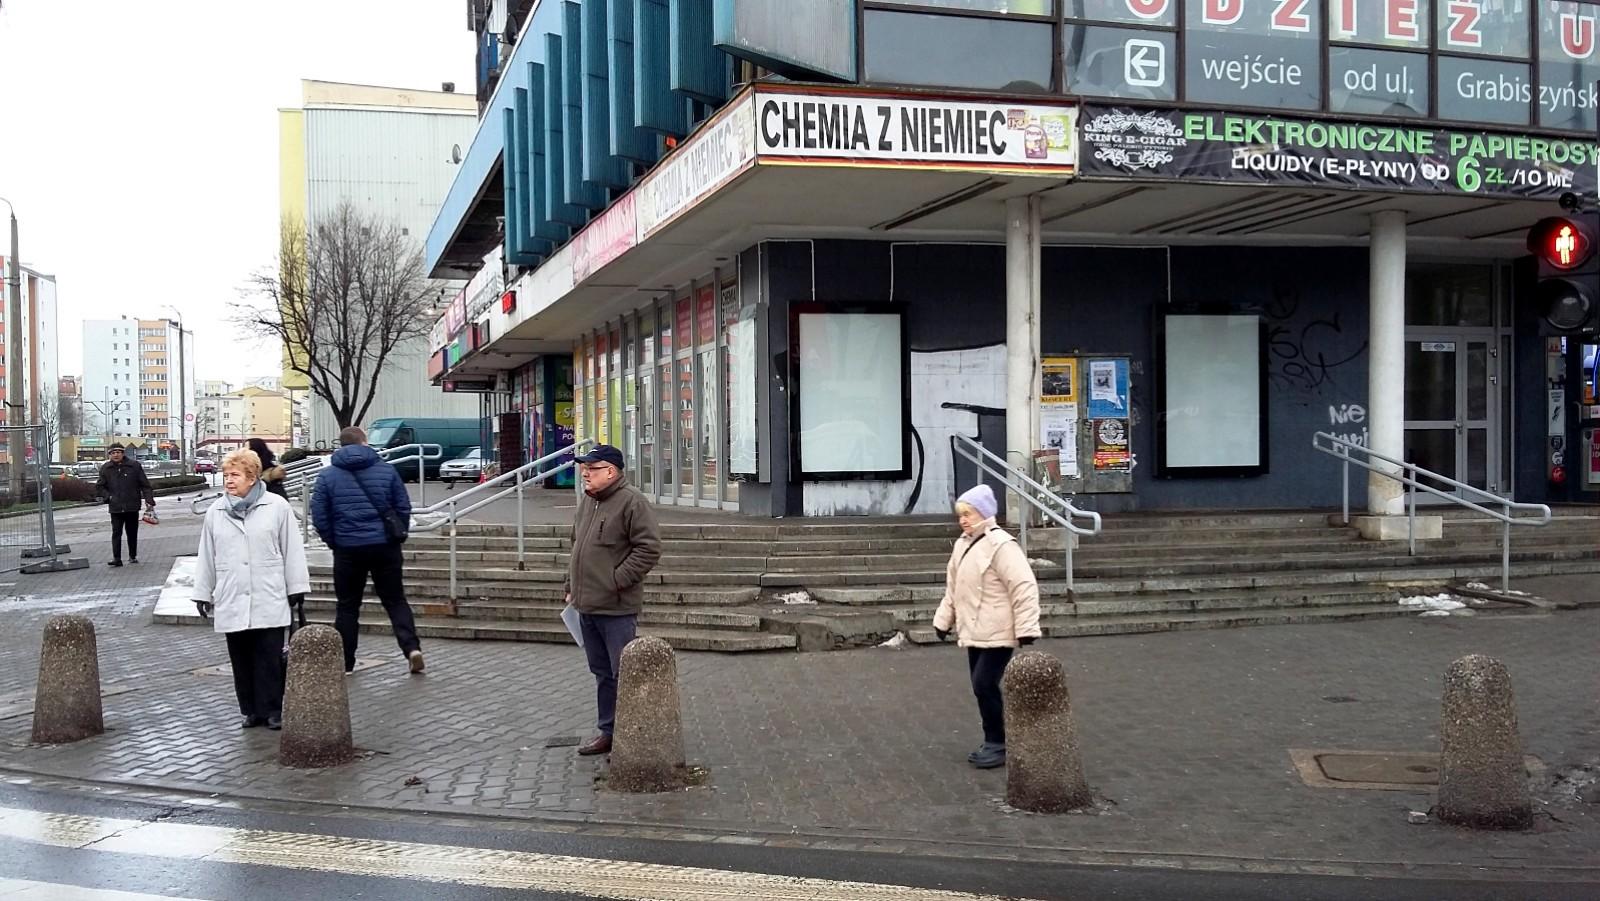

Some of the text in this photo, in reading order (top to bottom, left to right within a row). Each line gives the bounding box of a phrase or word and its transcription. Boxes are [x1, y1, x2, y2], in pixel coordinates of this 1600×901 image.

[1202, 54, 1302, 89] wejście
[1344, 64, 1377, 91] od
[1386, 66, 1414, 94] ul.
[761, 100, 1007, 156] CHEMIA Z NIEMIEC
[1084, 133, 1187, 146] KING E-CIGAR
[1184, 115, 1598, 166] ELEKTRONICZNE PAPIEROSY
[1231, 153, 1315, 173] LIQUIDY
[1320, 157, 1416, 184] (E-PŁYNY)
[1422, 164, 1450, 181] OD
[1457, 155, 1482, 192] 6
[1329, 404, 1366, 425] Nie
